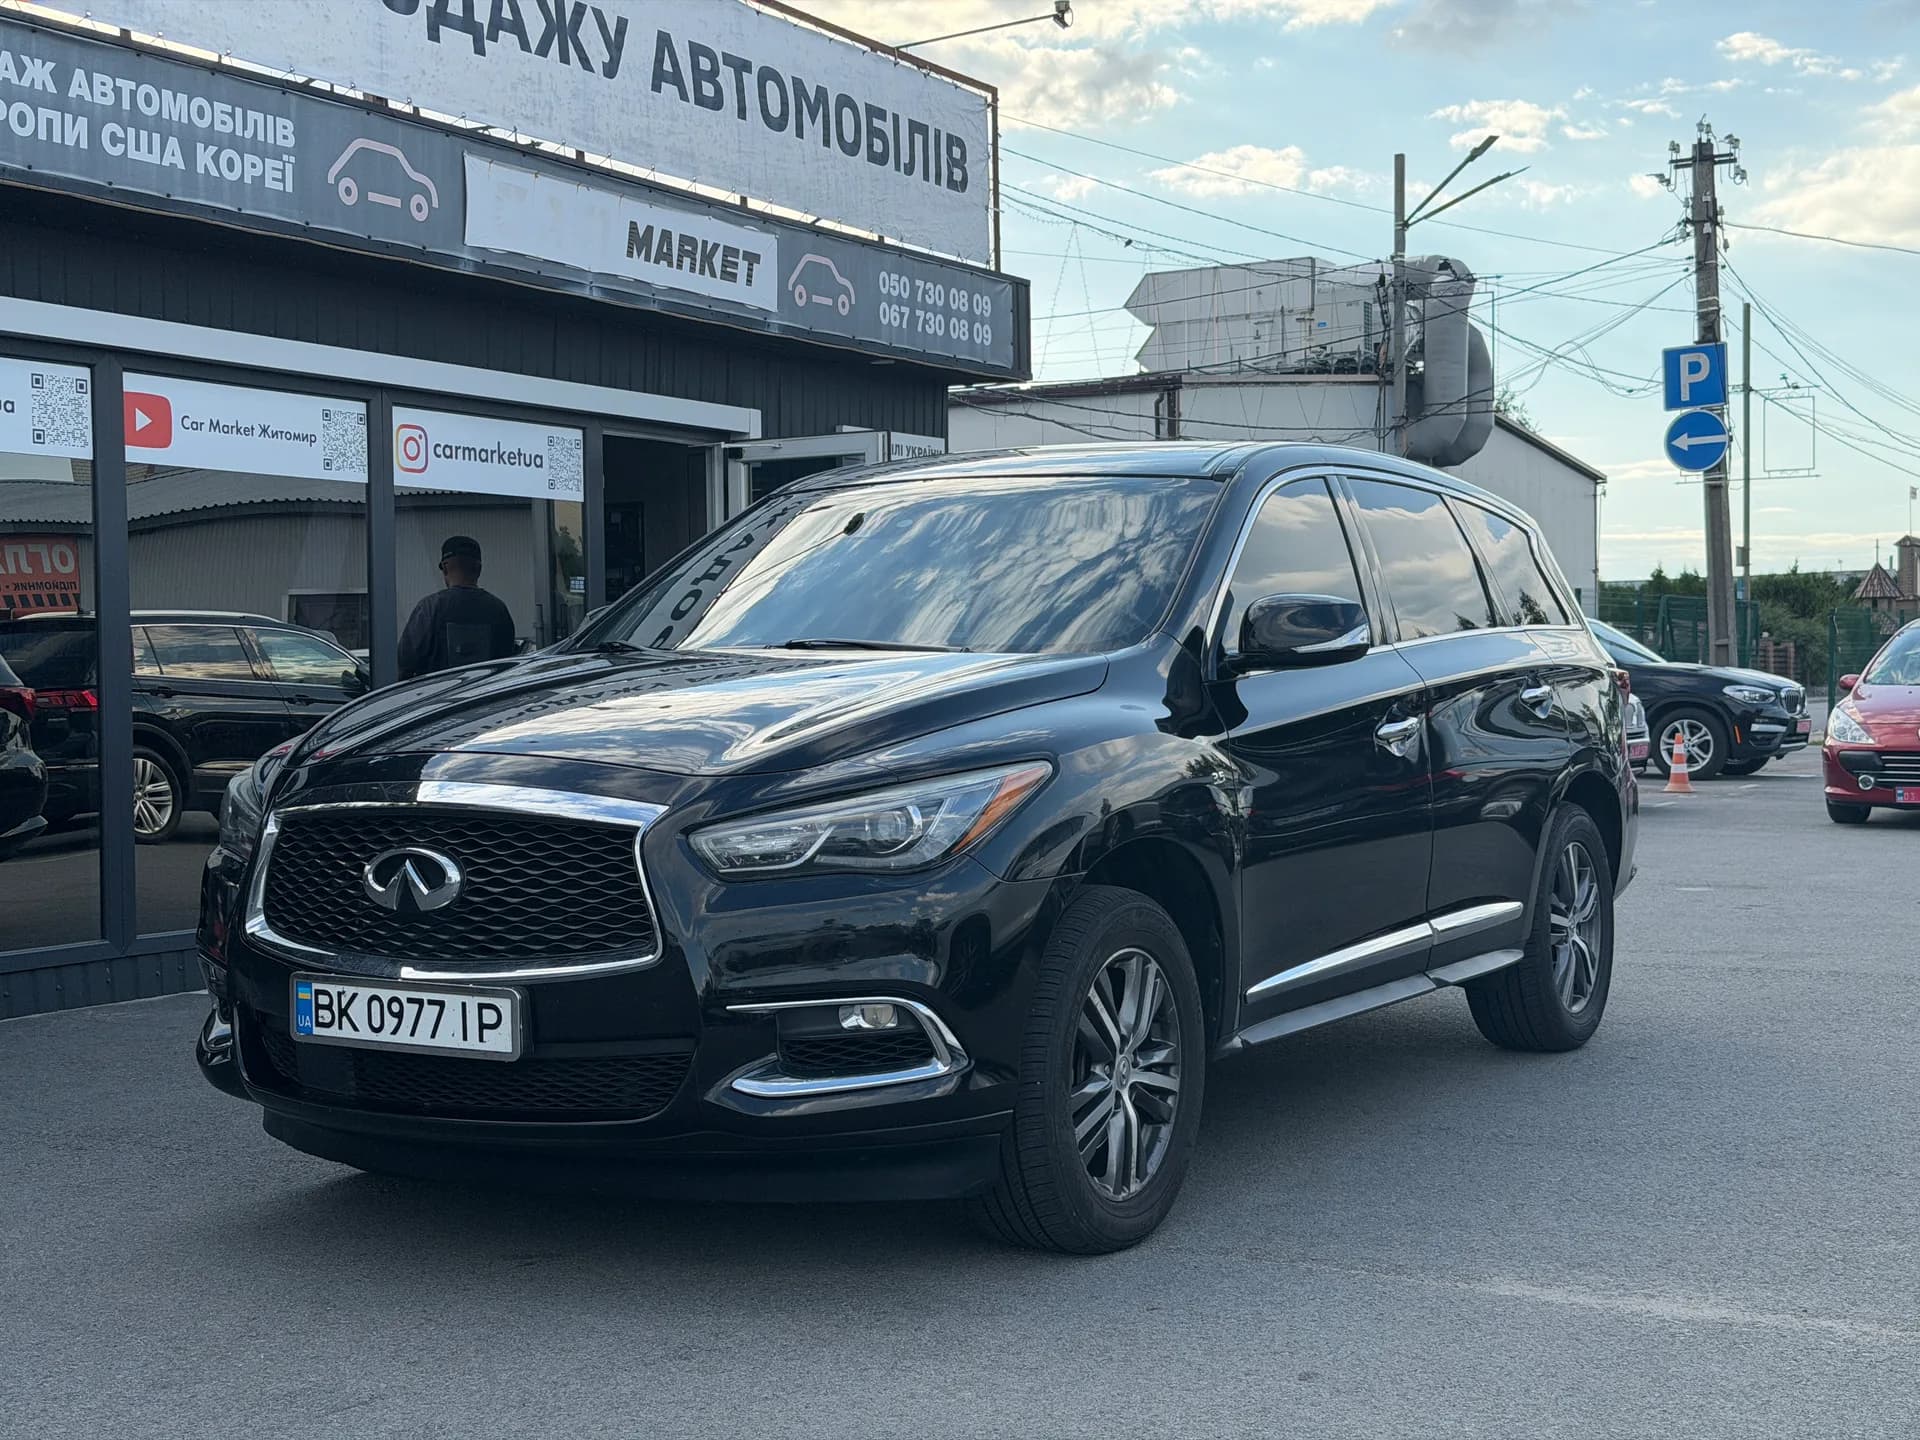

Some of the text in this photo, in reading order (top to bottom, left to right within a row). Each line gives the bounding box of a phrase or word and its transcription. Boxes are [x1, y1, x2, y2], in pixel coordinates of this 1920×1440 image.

[68, 67, 296, 148] АВТОМОБІЛІВ
[380, 0, 969, 193] ДАЖУ АВТОМОБІЛІВ
[101, 122, 185, 169] США
[196, 142, 296, 193] КОРЕЇ
[626, 221, 761, 287] MARKET
[879, 271, 992, 317] 050 730 08 09
[879, 302, 992, 346] 067 730 08 09
[1680, 352, 1710, 401] P
[181, 415, 317, 447] Car Market Житомир
[433, 441, 543, 468] carmarketua
[298, 1014, 311, 1028] UA
[313, 988, 502, 1043] BK 0977 IP
